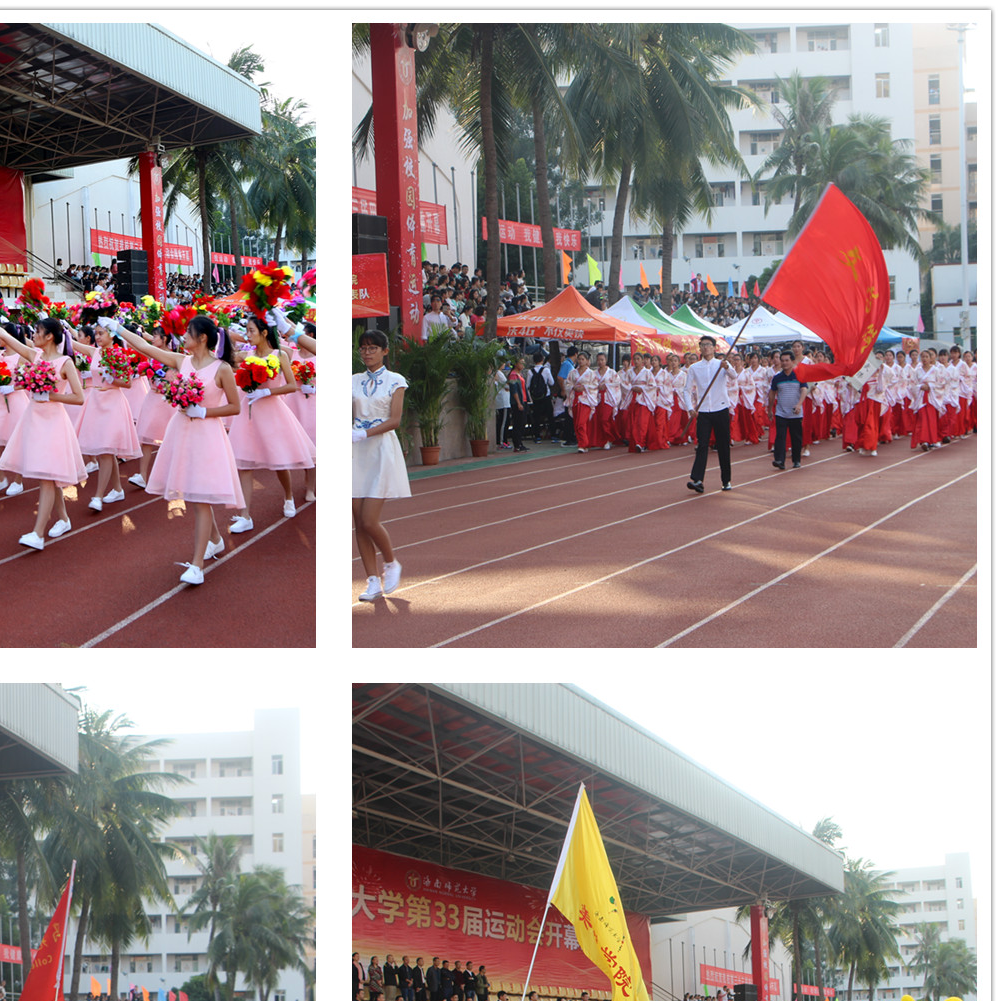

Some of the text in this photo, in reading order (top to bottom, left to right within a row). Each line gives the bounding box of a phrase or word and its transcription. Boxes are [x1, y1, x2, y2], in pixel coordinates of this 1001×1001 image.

[401, 92, 420, 325] 加强校园体育运动
